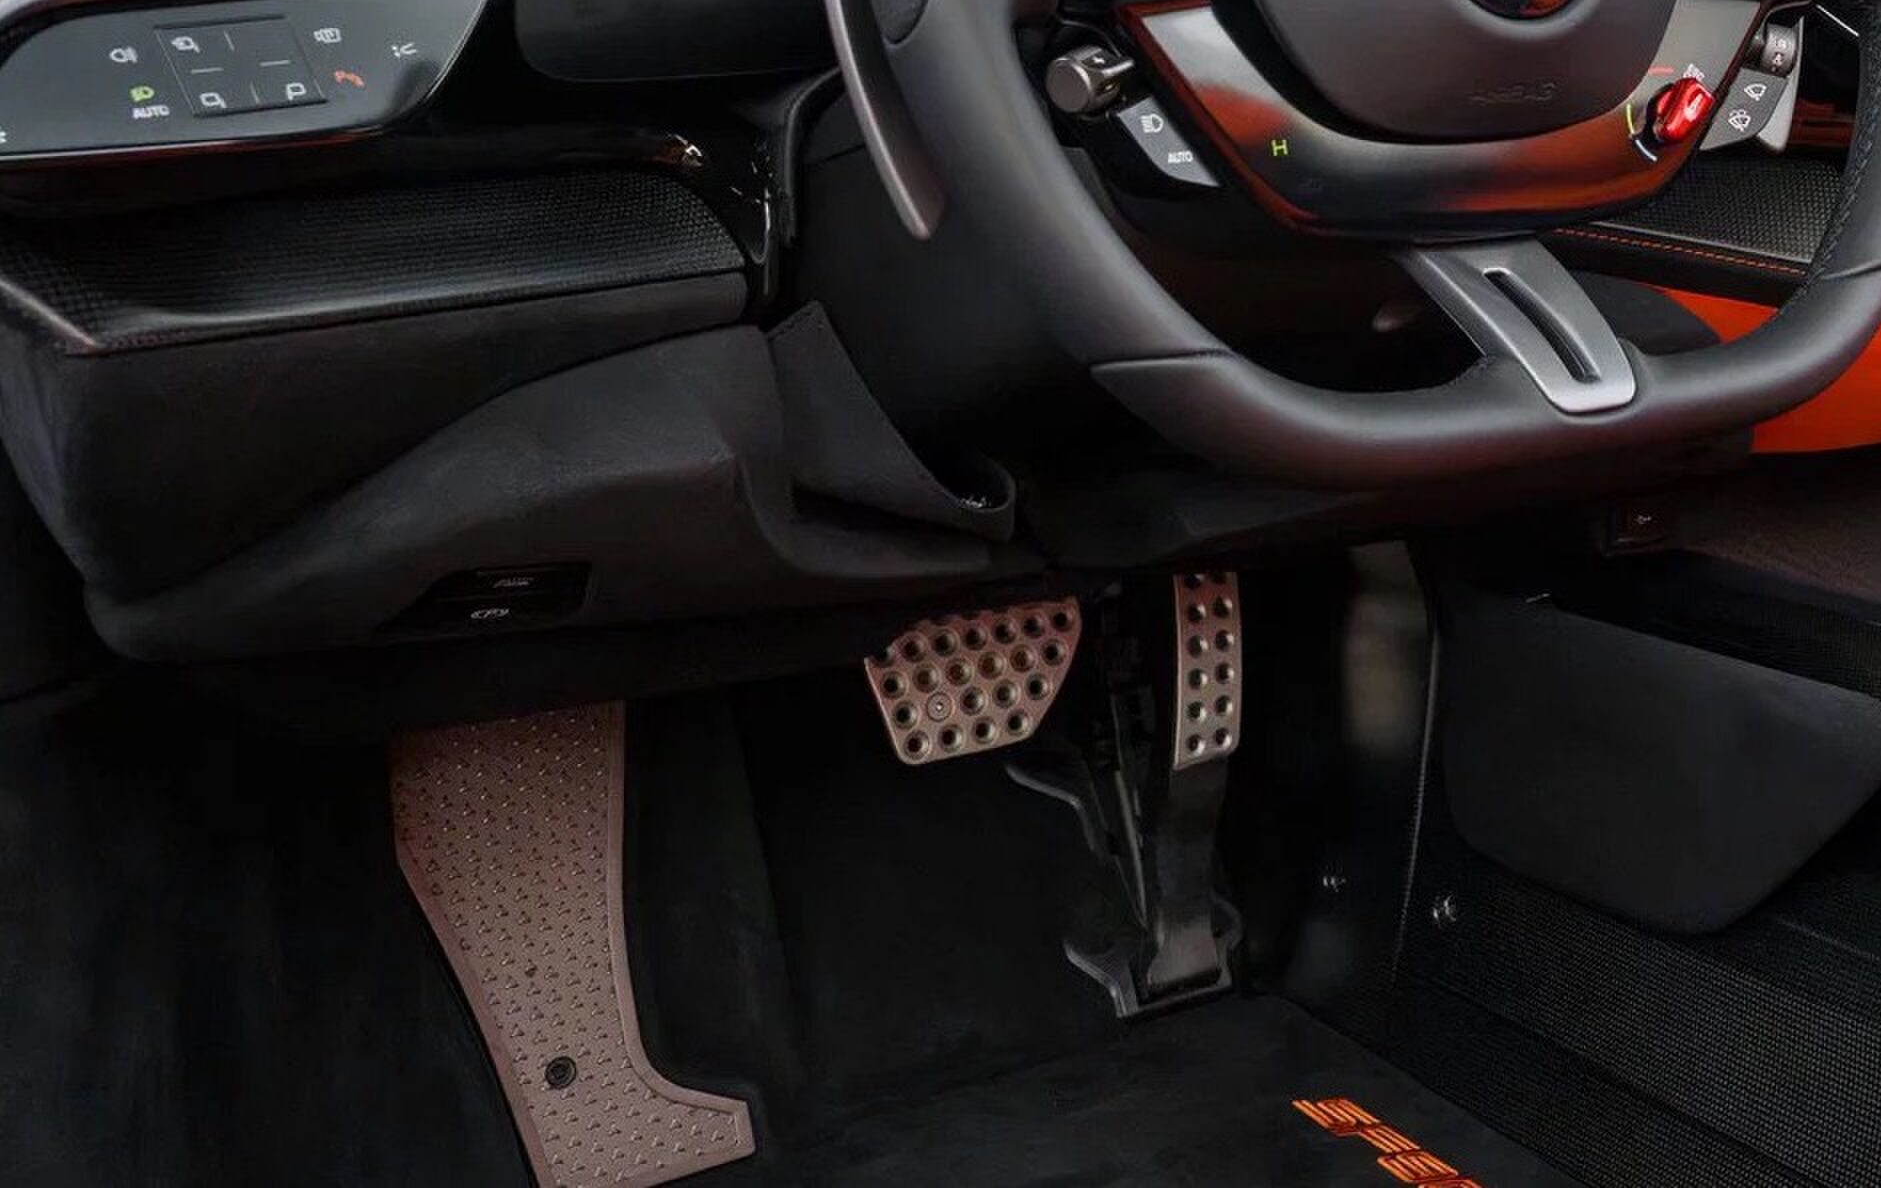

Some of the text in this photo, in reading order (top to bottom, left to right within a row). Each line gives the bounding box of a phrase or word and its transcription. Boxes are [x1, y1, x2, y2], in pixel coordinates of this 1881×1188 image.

[132, 104, 170, 119] AUTO
[1271, 139, 1289, 156] H
[1167, 150, 1194, 164] AUTO
